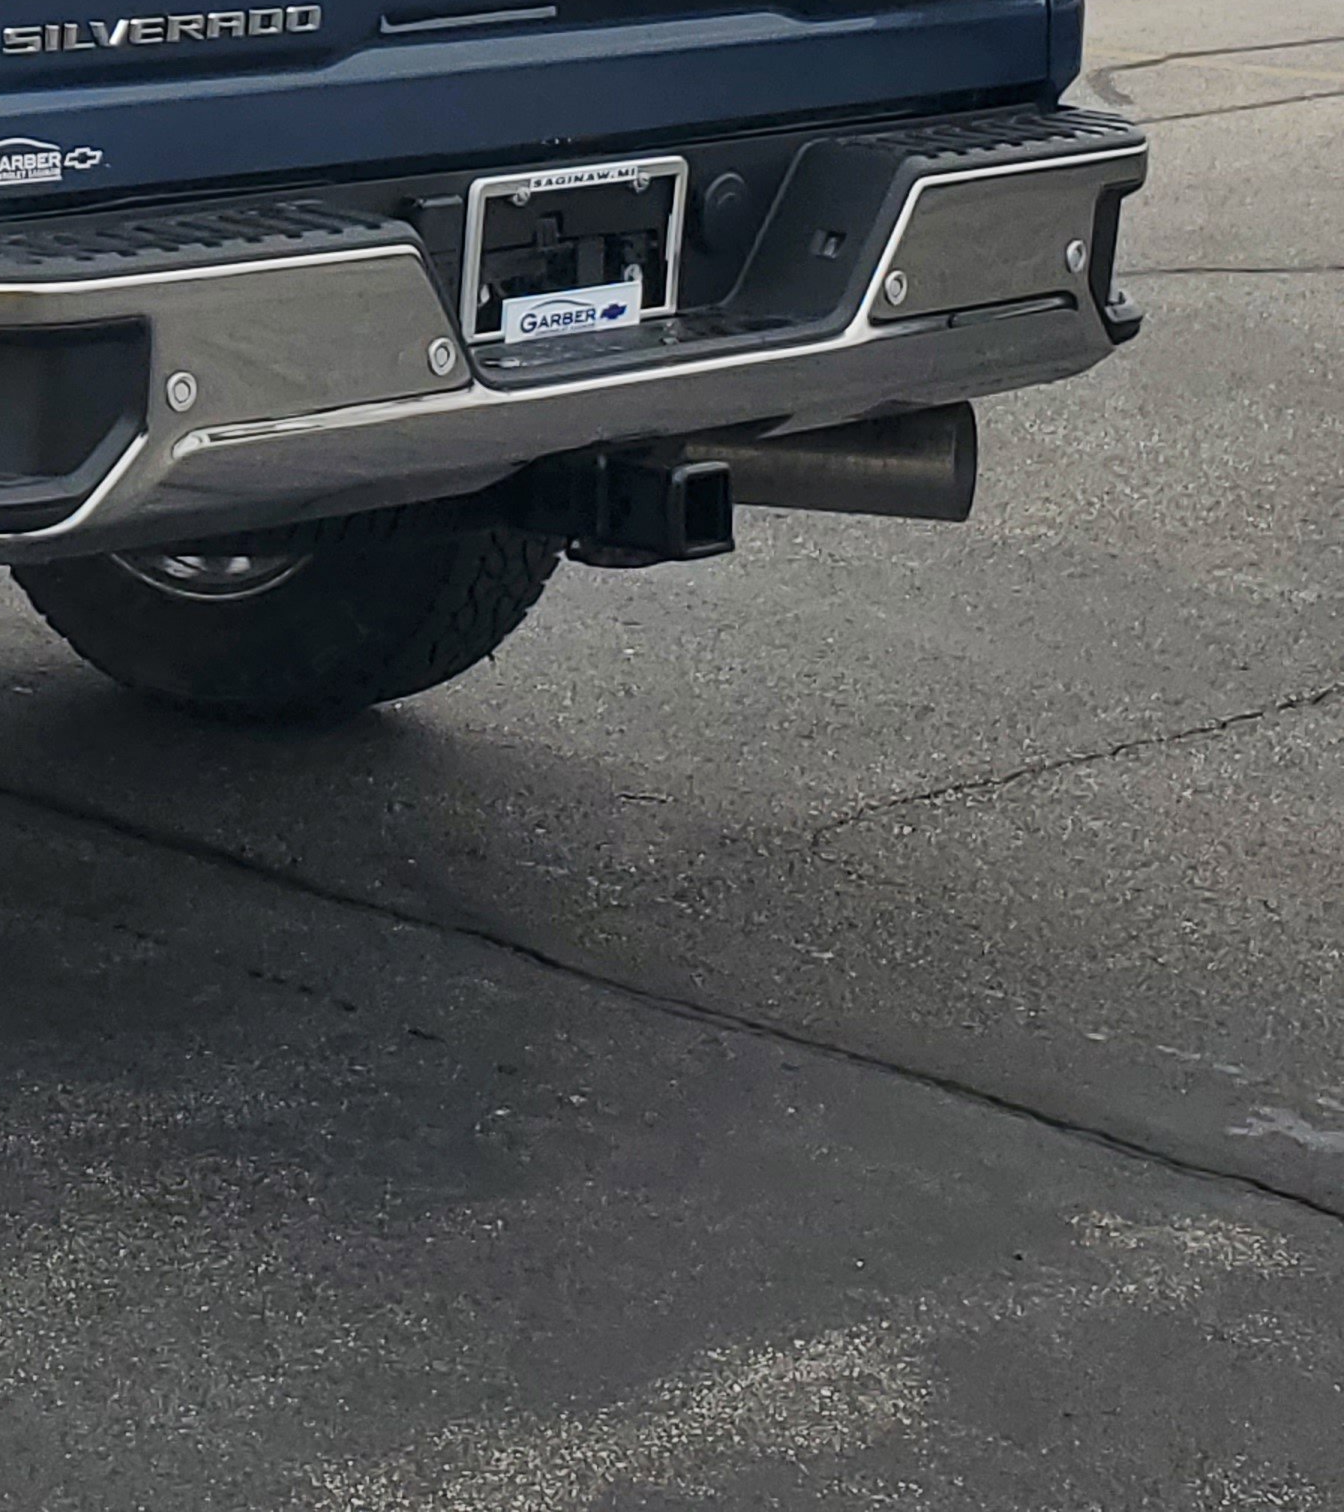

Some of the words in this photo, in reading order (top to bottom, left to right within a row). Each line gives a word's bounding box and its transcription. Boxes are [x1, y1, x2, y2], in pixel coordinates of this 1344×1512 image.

[3, 5, 321, 54] SILVERADO
[618, 167, 635, 177] MI
[520, 308, 597, 334] GARBER
